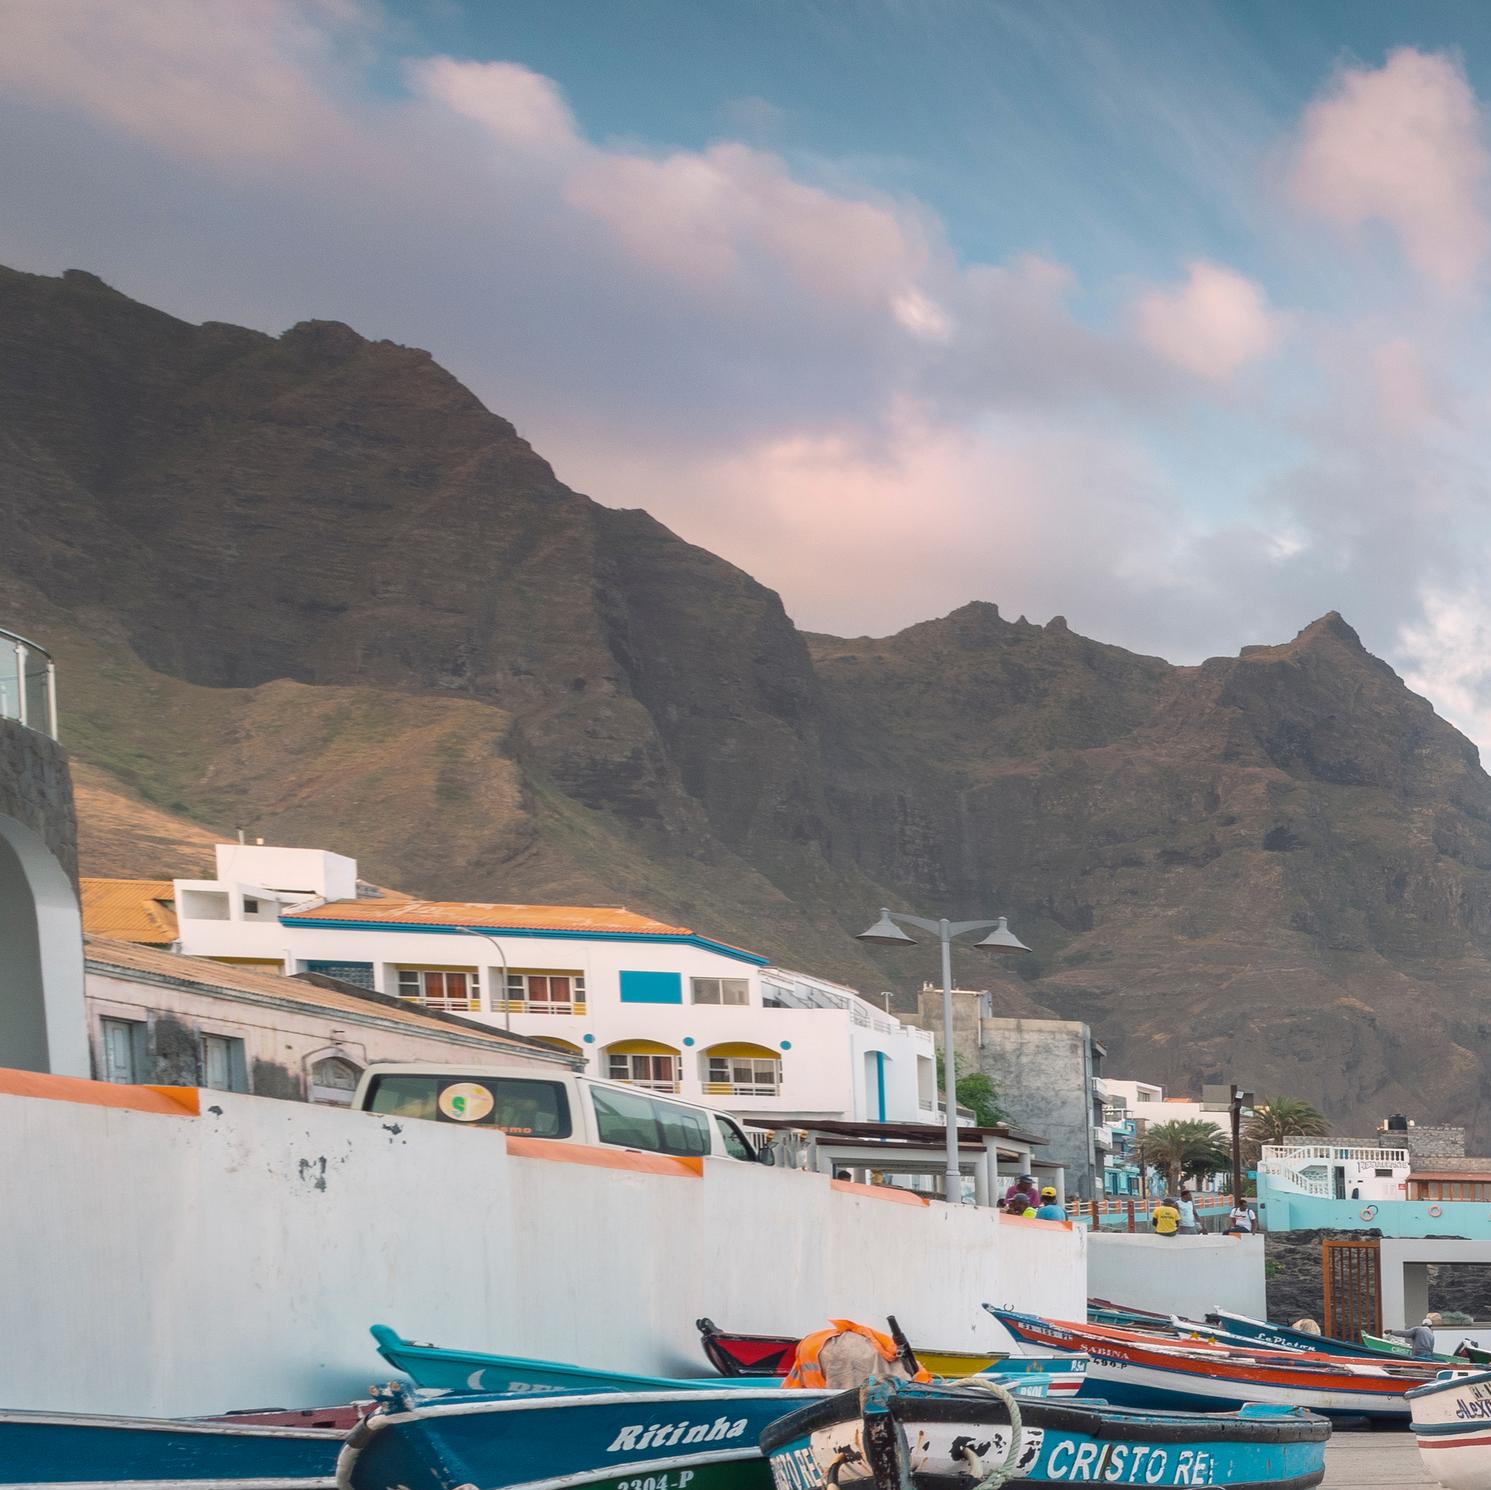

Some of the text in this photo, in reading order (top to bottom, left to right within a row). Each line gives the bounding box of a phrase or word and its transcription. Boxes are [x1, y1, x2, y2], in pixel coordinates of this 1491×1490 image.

[1080, 1344, 1130, 1360] SABINA
[607, 1416, 748, 1451] Ritinha
[1047, 1440, 1167, 1484] CRISTO
